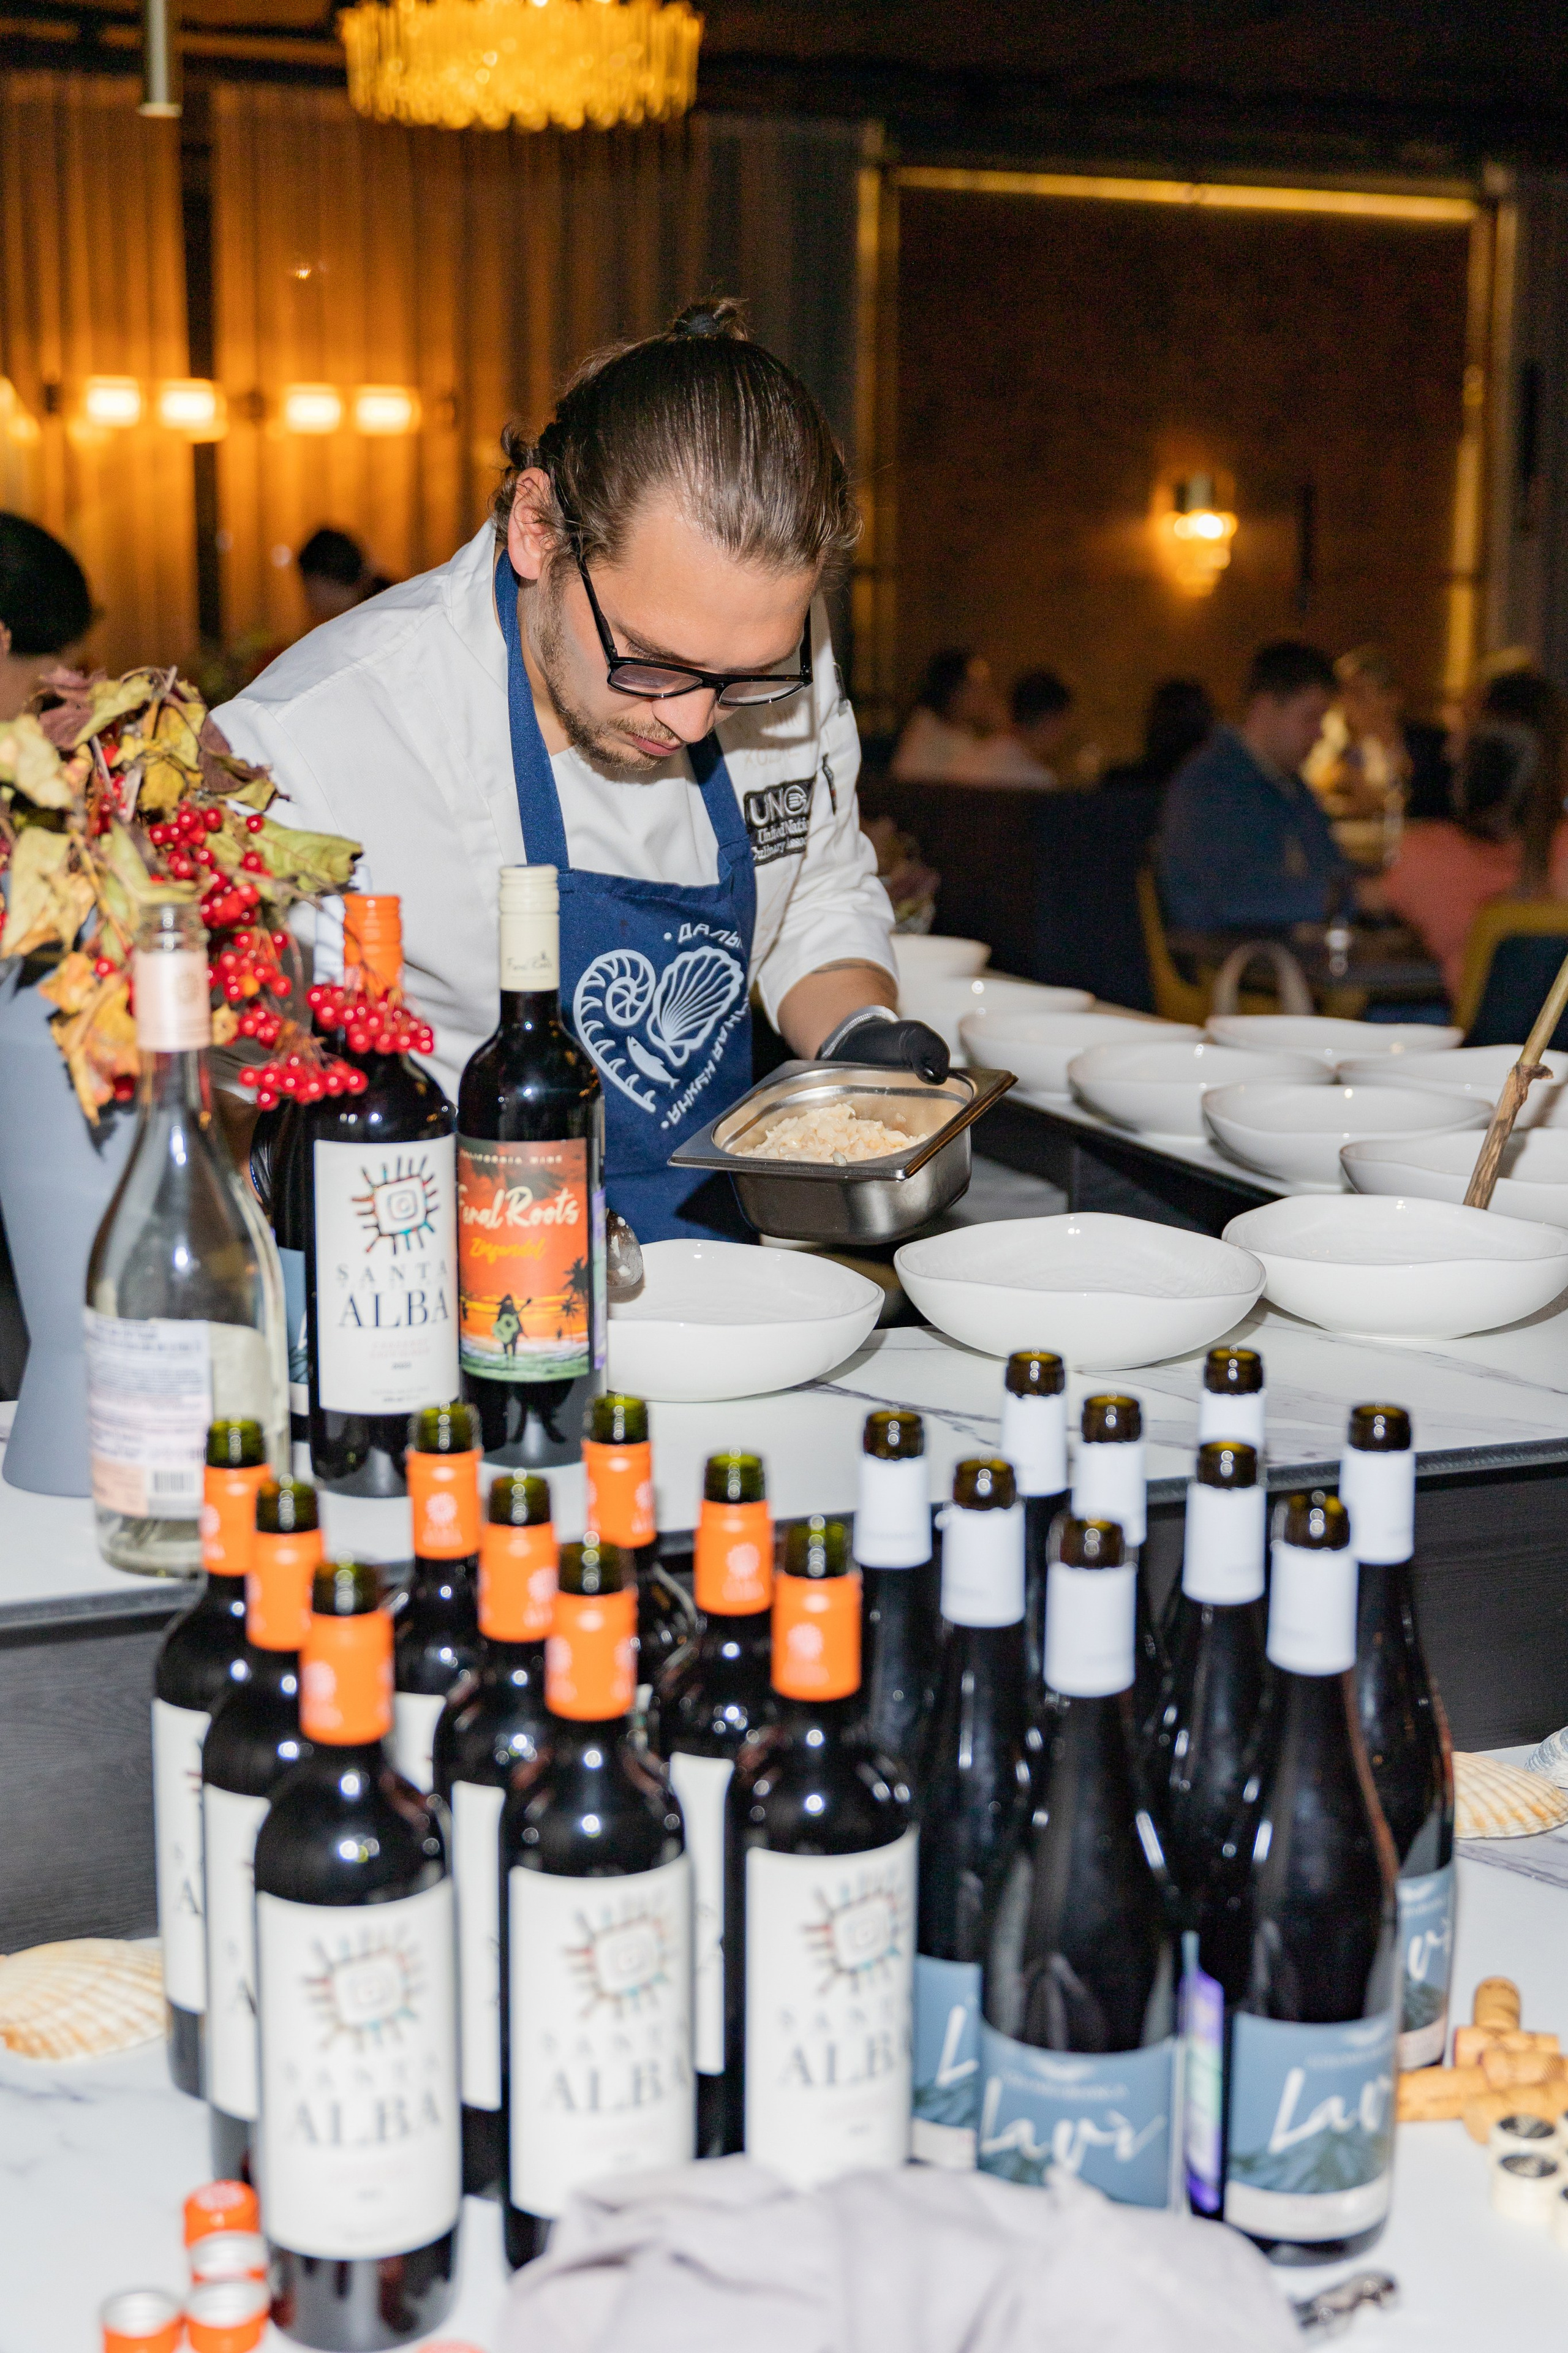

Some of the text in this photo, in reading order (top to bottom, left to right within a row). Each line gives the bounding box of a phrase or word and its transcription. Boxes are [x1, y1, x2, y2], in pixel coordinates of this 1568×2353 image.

[505, 1186, 581, 1228] Roots
[337, 1258, 448, 1282] SANTA
[338, 1287, 449, 1328] ALBA
[285, 2088, 442, 2147] ALBA
